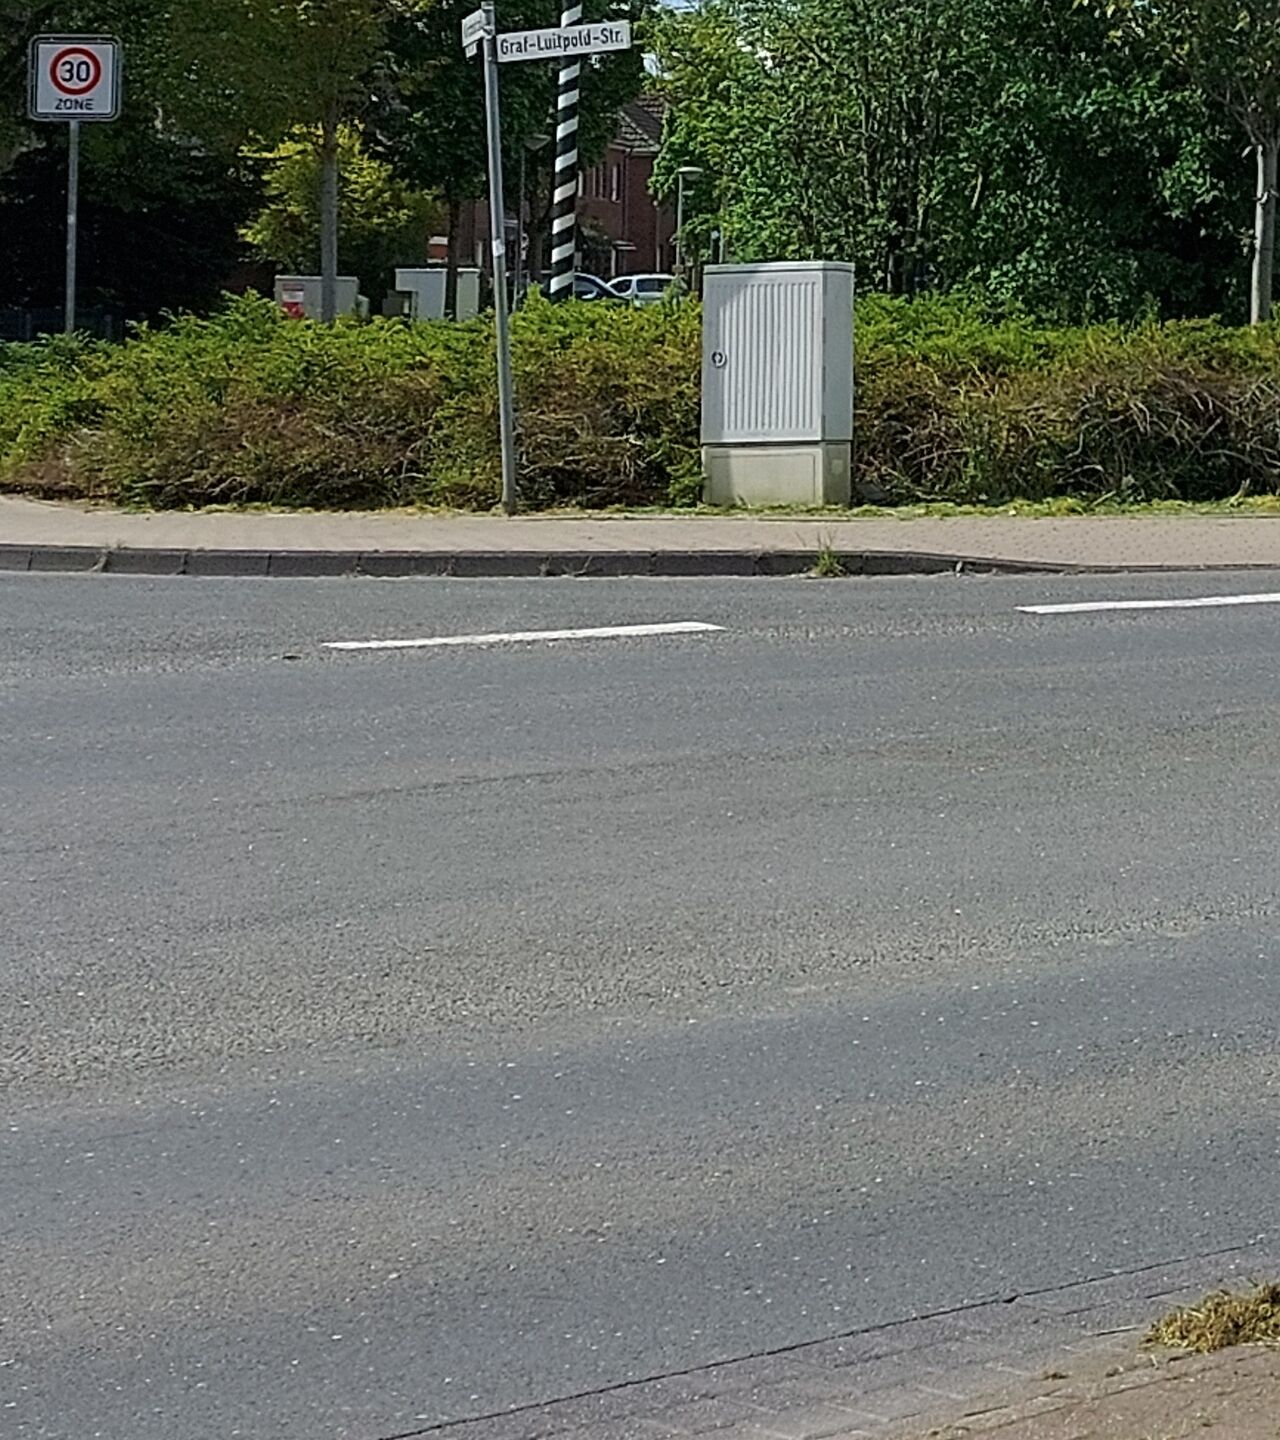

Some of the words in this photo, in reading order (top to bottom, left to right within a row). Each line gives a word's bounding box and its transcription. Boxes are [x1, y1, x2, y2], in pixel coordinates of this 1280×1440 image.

[500, 27, 624, 56] Graf-Luitpold-Str.
[60, 60, 91, 83] 30
[55, 98, 94, 111] ZONE
